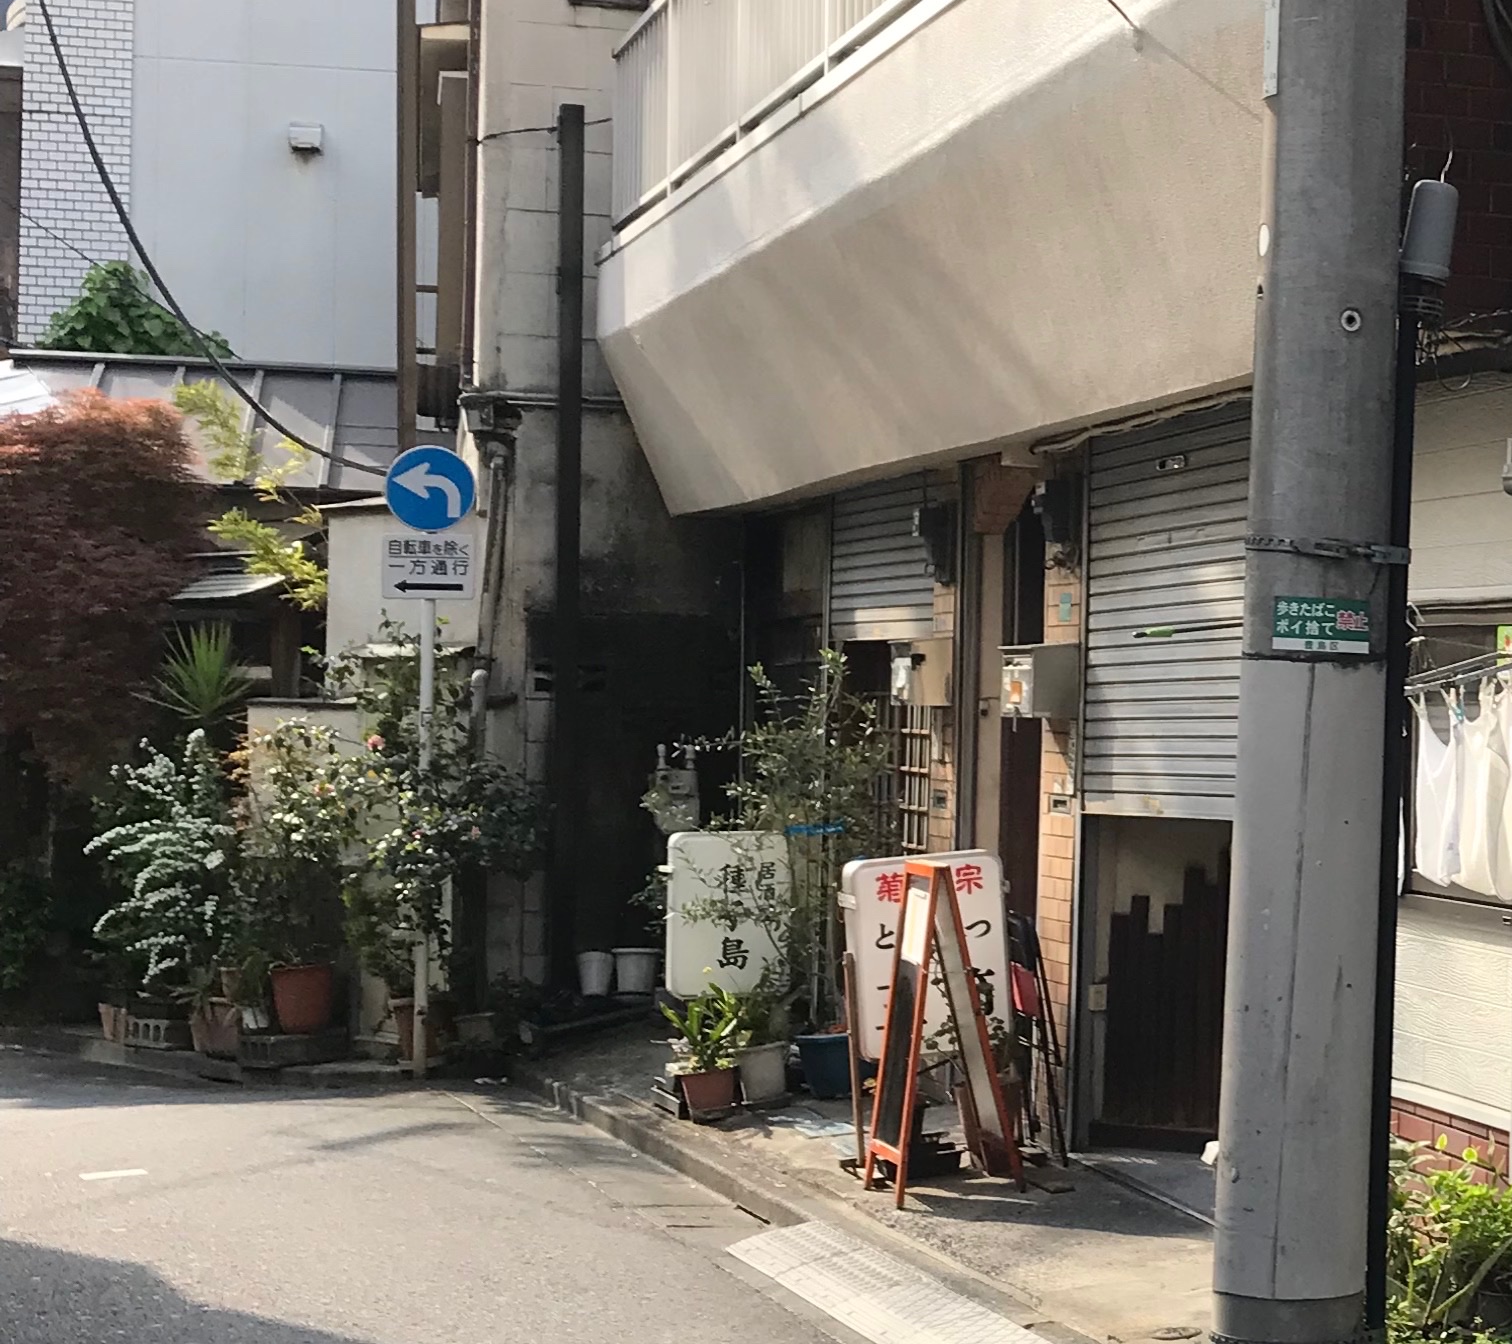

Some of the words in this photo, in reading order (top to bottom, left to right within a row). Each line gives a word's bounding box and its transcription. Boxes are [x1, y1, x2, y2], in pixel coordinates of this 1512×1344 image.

[388, 540, 470, 556] 自転車を除く
[388, 560, 469, 576] 一方通行
[1276, 601, 1336, 617] 歩きたばこ
[1276, 619, 1336, 636] ポイ捨て
[1335, 609, 1369, 632] 禁止
